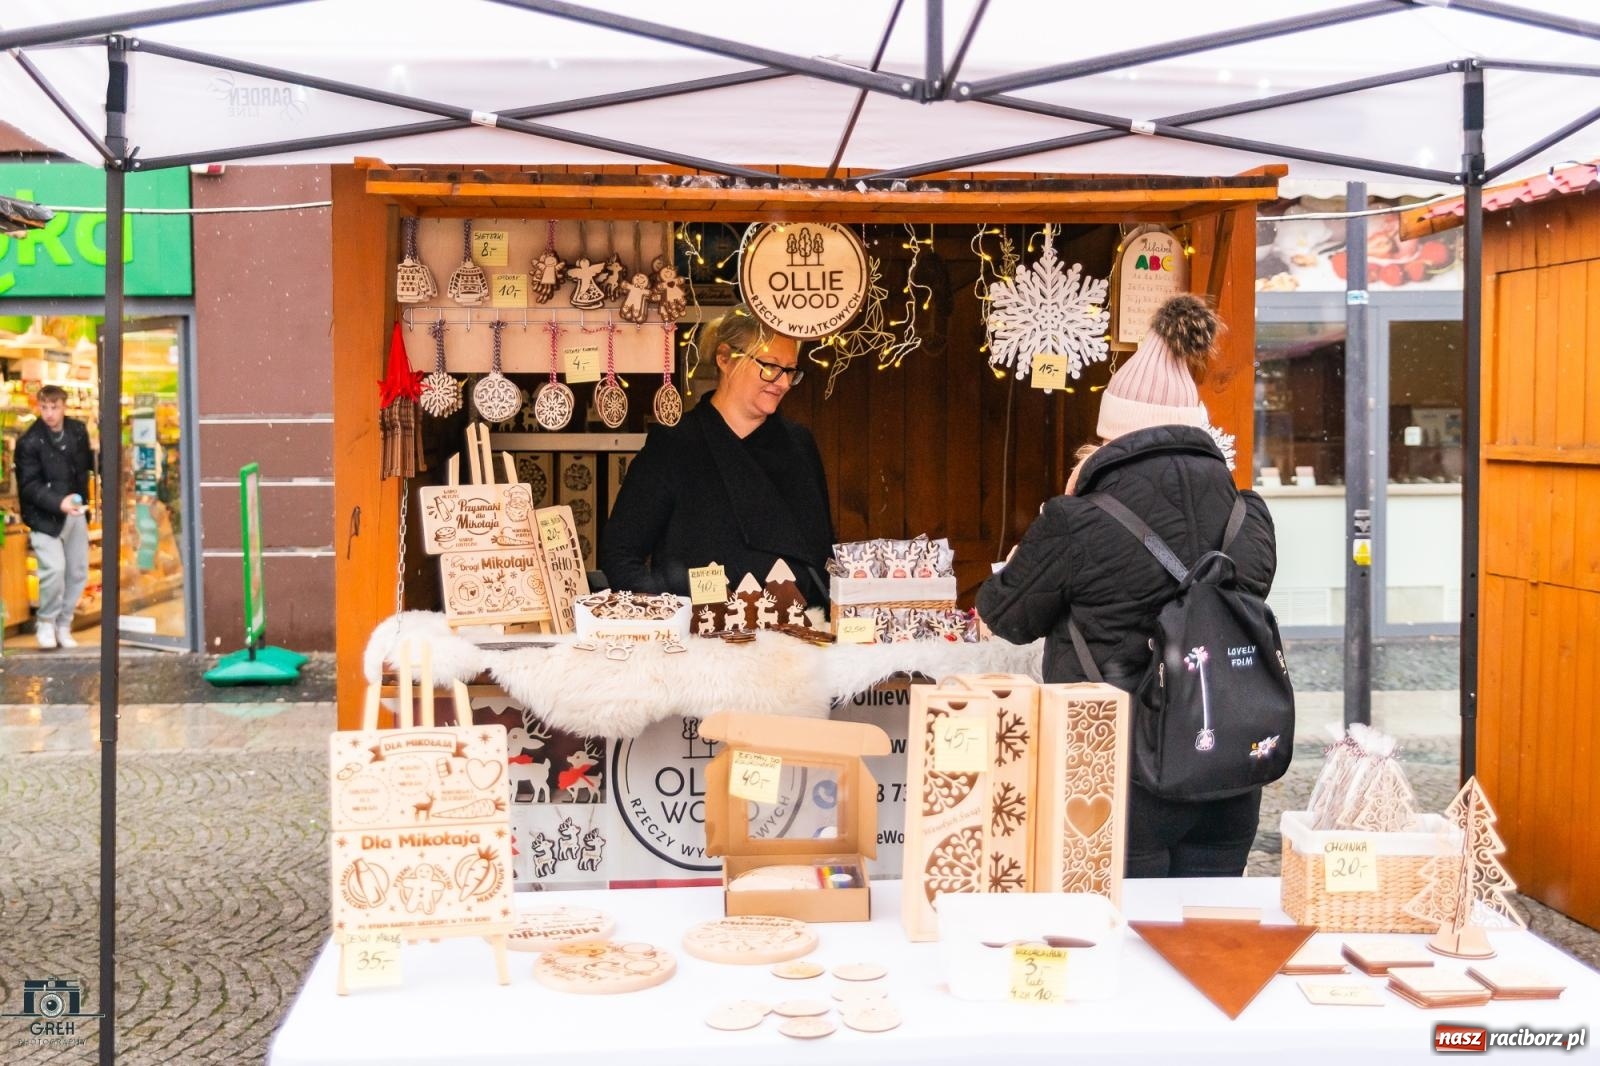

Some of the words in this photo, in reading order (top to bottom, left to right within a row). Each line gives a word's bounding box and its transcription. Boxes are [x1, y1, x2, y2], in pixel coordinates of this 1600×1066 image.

[1135, 255, 1176, 272] ABC
[769, 270, 844, 292] OLLIE
[773, 293, 840, 309] WOOD
[750, 295, 783, 327] RZECZY
[788, 292, 861, 335] WYJĄTKOWYCH
[458, 498, 501, 512] Przysmaki
[1227, 645, 1256, 656] LOVELY
[384, 739, 402, 751] DLA
[630, 797, 676, 848] RZECZY
[361, 834, 392, 850] Dla
[399, 832, 481, 848] Mikołaja
